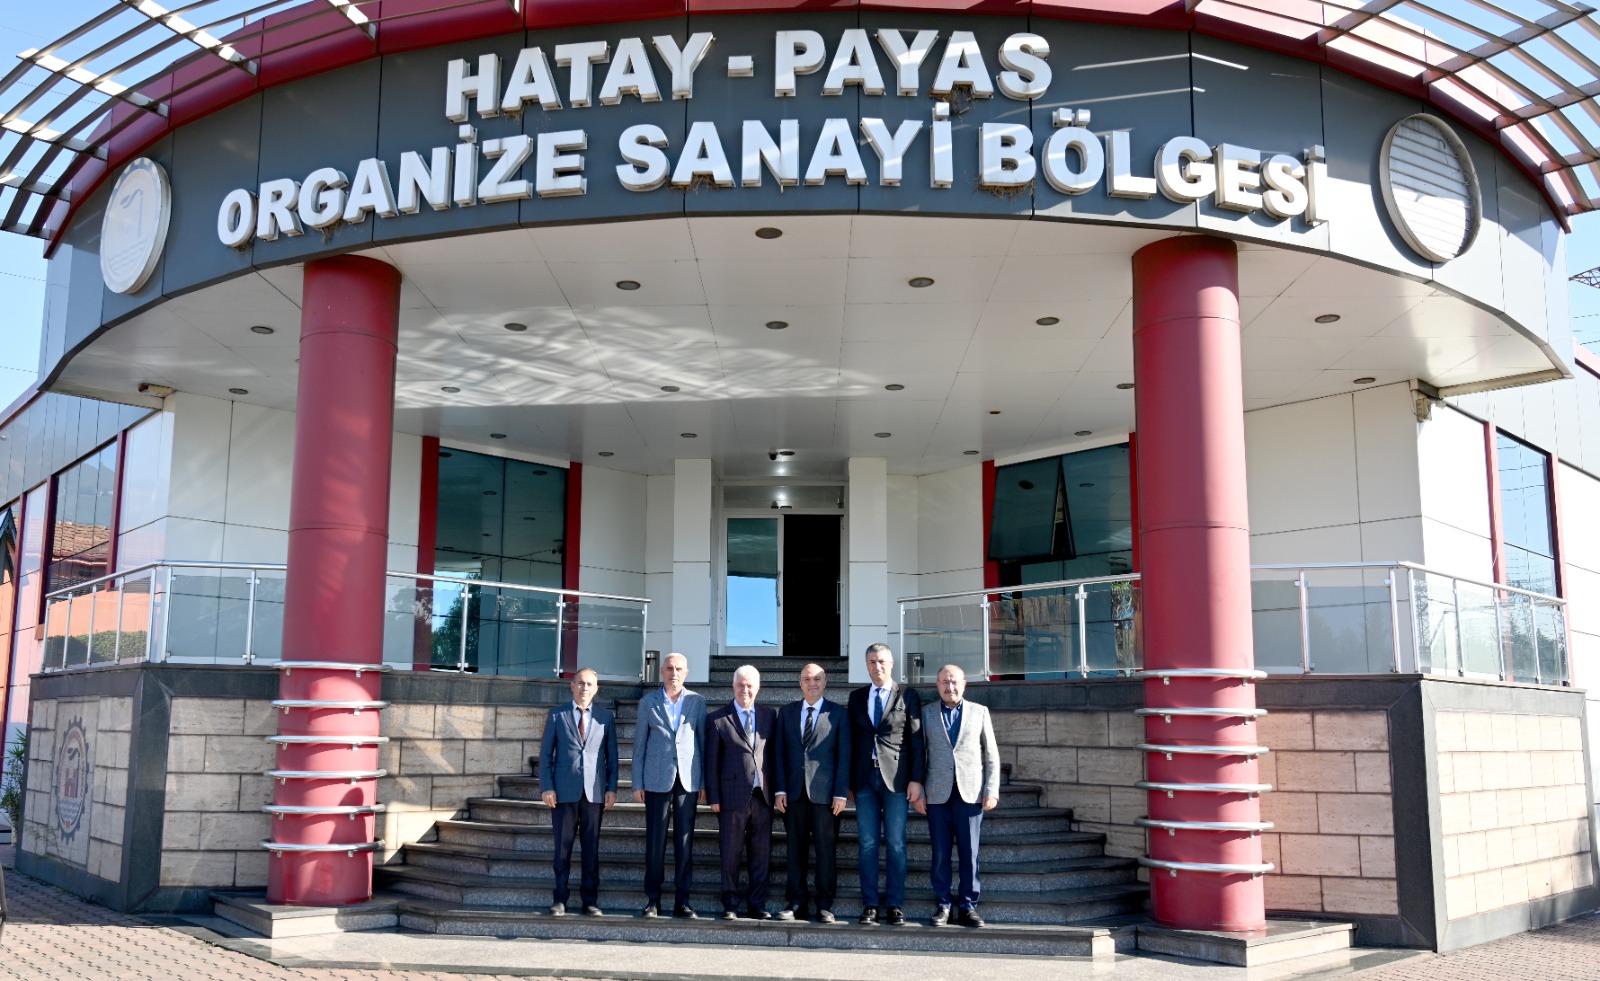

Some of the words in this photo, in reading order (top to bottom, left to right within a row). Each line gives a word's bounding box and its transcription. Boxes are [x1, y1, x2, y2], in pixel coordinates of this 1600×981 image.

[446, 32, 714, 123] HATAY
[728, 55, 754, 77] -
[775, 29, 1052, 100] PAYAS
[217, 125, 588, 249] ORGANİZE
[616, 102, 953, 191] SANAYİ
[979, 108, 1329, 226] BÖLGESİ
